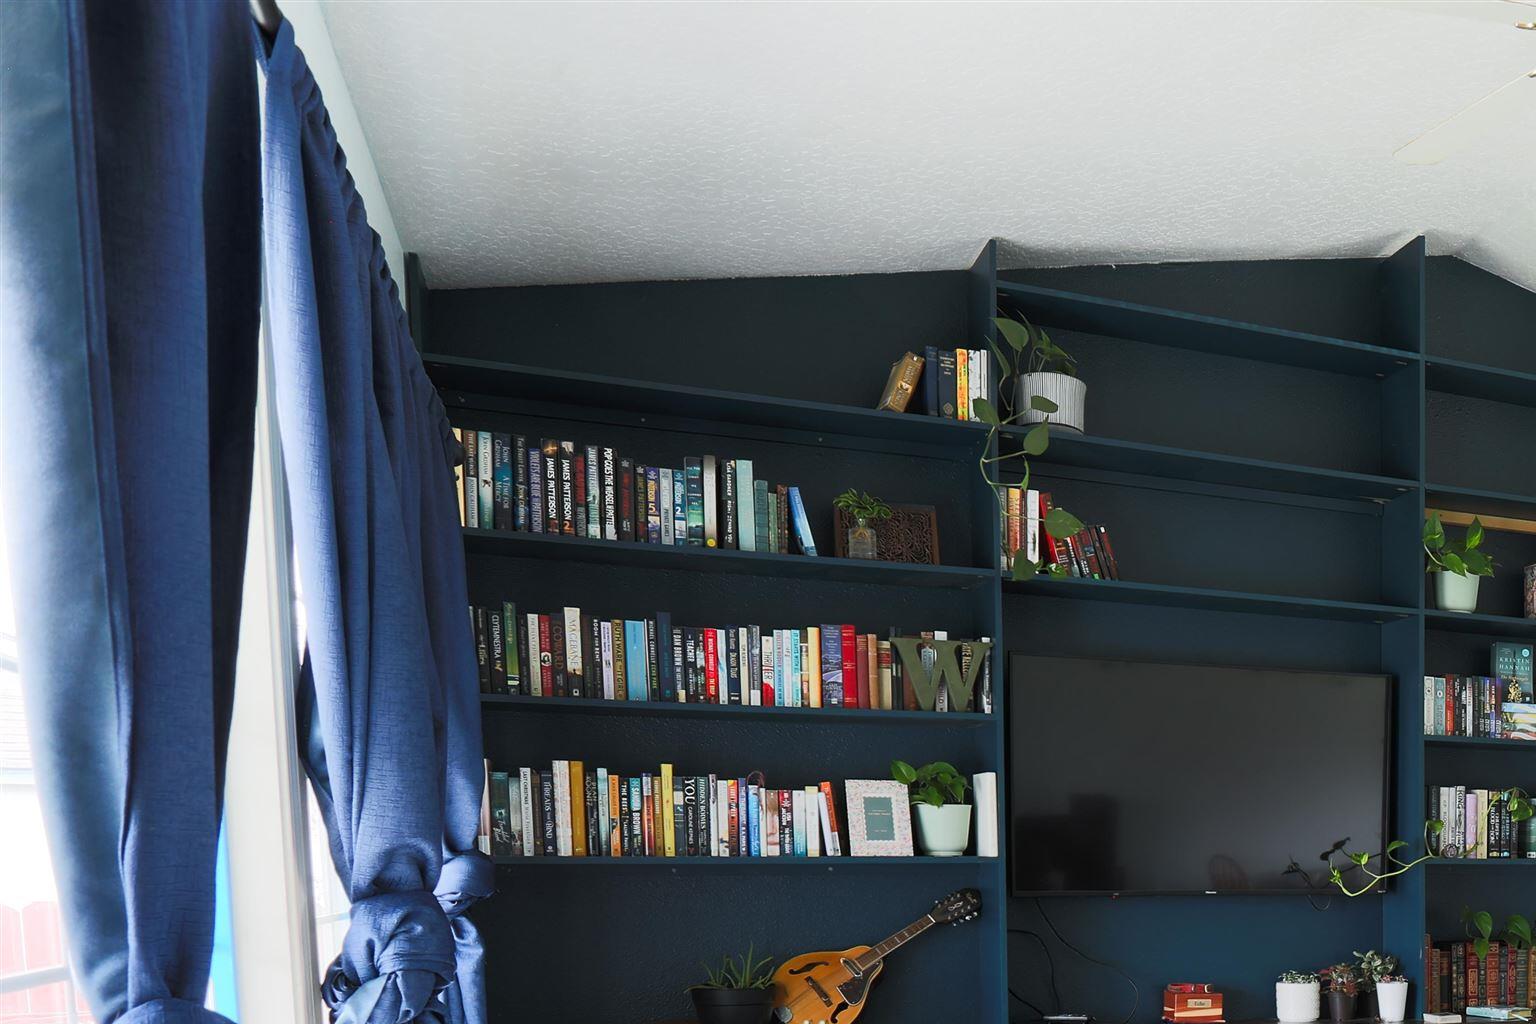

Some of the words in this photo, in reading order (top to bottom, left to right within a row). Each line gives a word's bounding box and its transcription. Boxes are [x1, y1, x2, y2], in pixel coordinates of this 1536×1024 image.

[482, 437, 490, 450] JOHN
[604, 448, 613, 460] POP
[530, 452, 540, 473] VIOLETS
[588, 448, 596, 465] JAMES
[546, 458, 554, 479] JAMES
[562, 460, 570, 481] JAMES
[605, 460, 613, 475] GOES
[531, 474, 540, 483] ARE
[605, 475, 614, 485] THE
[532, 484, 540, 497] BLUE
[548, 480, 556, 519] PATTERSON
[564, 482, 572, 520] PATTERSON
[606, 486, 614, 505] WEASEL
[532, 502, 541, 532] PATTERSON
[492, 615, 501, 658] CLYTEMNESTRA
[568, 619, 579, 665] MAGEBANE
[614, 622, 622, 642] RUTH
[554, 626, 564, 669] COWARD
[674, 647, 682, 666] BROWN
[686, 640, 695, 662] TEACHER
[616, 670, 623, 678] IT
[889, 637, 993, 711] W
[544, 782, 552, 811] THREADS
[632, 788, 641, 811] SANDRA
[684, 778, 695, 804] YOU
[546, 820, 554, 839] BIND
[632, 812, 641, 835] BROWN
